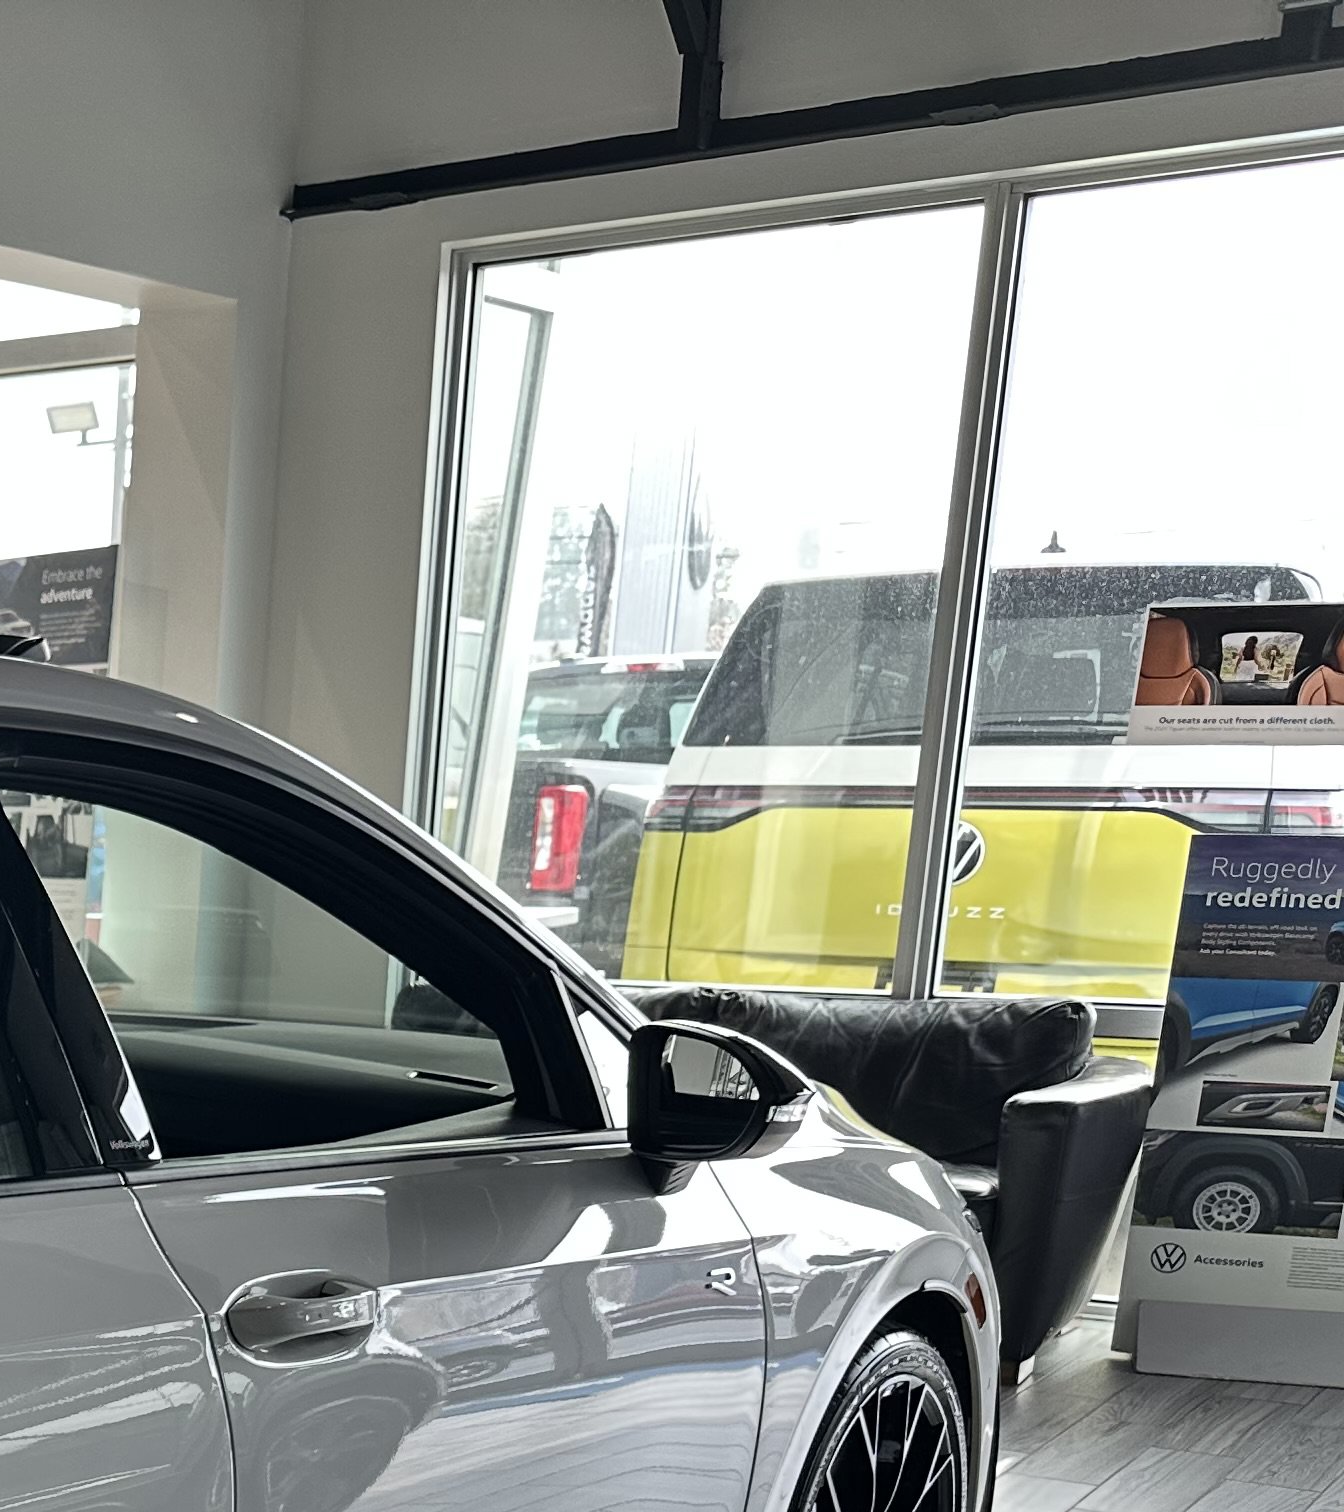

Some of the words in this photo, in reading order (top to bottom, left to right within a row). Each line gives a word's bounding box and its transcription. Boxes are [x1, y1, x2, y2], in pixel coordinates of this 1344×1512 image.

[41, 568, 85, 585] Embrace
[85, 565, 103, 580] the
[40, 588, 93, 604] adventure
[1159, 716, 1175, 725] Our
[1177, 716, 1201, 725] seats
[1202, 717, 1217, 725] are
[1218, 717, 1234, 725] cut
[1235, 716, 1257, 725] from
[1266, 716, 1307, 725] different
[1309, 716, 1336, 726] cloth.
[1211, 856, 1337, 885] Ruggedly
[1205, 886, 1343, 909] redefined
[1193, 1253, 1264, 1269] Accessories
